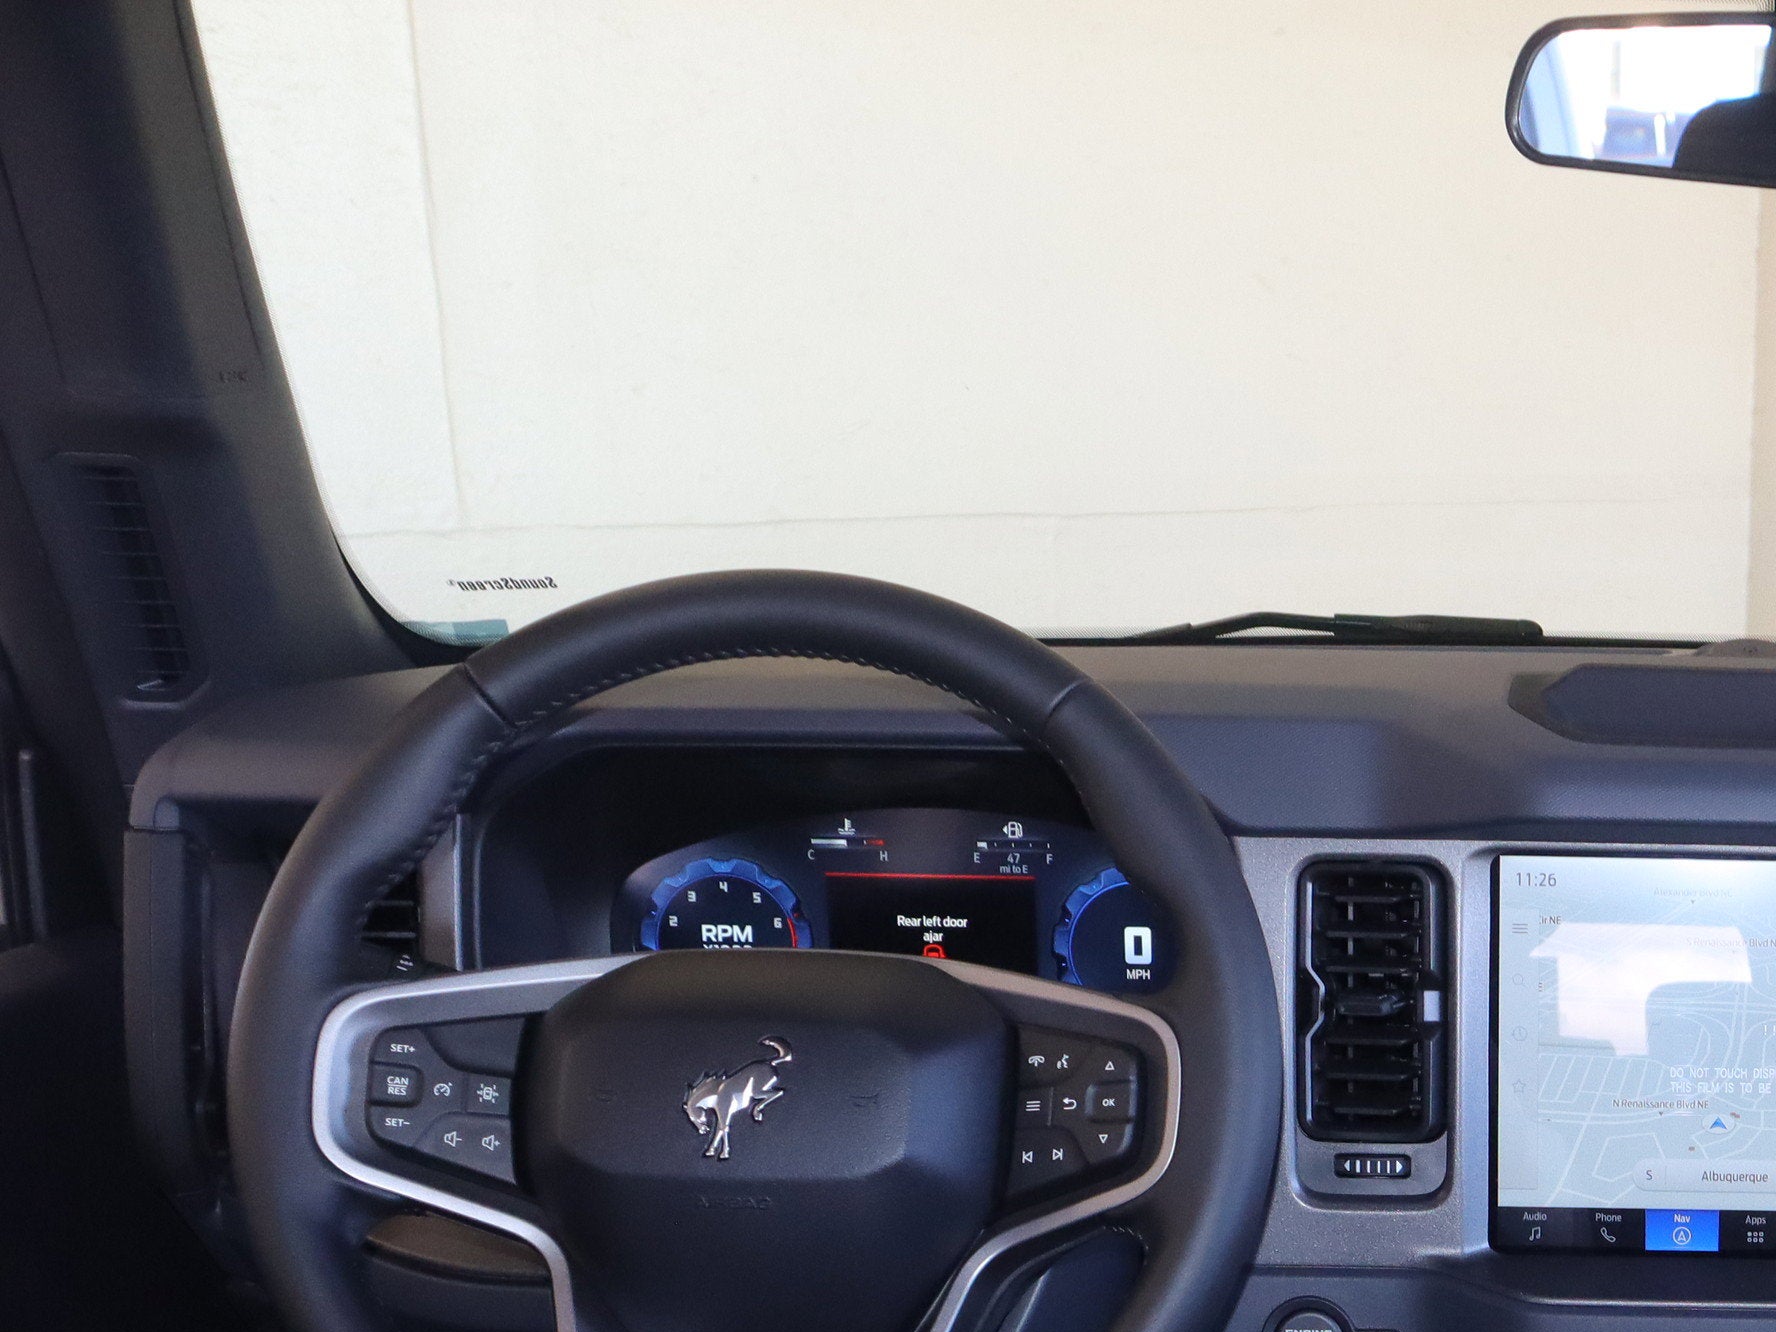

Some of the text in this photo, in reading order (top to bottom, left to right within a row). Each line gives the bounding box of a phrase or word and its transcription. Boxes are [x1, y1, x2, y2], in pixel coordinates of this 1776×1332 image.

[807, 849, 815, 860] C
[879, 850, 888, 861] H
[973, 852, 981, 864] E
[1006, 853, 1020, 863] 47
[1046, 853, 1053, 865] F
[1000, 864, 1028, 874] mi to E
[1516, 872, 1557, 887] 11:26
[719, 881, 729, 893] 4
[687, 890, 697, 902] 3
[752, 891, 762, 904] 5
[668, 915, 678, 926] 2
[773, 917, 782, 929] 6
[896, 915, 967, 928] Rear left door
[701, 924, 753, 943] RPM
[923, 930, 943, 943] ajar
[1123, 926, 1152, 964] 0
[1126, 968, 1151, 980] MPH
[390, 1043, 416, 1053] SET+
[1669, 1067, 1685, 1079] DO
[1689, 1067, 1710, 1079] NOT
[1714, 1067, 1748, 1079] TOUCH
[386, 1075, 409, 1085] CAN
[387, 1086, 407, 1096] RES
[1670, 1082, 1692, 1093] THIS
[1697, 1082, 1721, 1093] FILM
[1724, 1082, 1735, 1093] IS
[1739, 1082, 1753, 1094] TO
[1758, 1083, 1772, 1094] BE
[1102, 1098, 1116, 1107] OK
[1621, 1099, 1674, 1109] Renaissance
[1676, 1100, 1696, 1109] Blvd
[1646, 1169, 1653, 1181] S
[1701, 1170, 1769, 1184] Albuquerque
[1523, 1211, 1547, 1222] Audio
[1595, 1212, 1622, 1223] Phone
[1673, 1213, 1691, 1223] Nav
[1745, 1214, 1767, 1226] Apps
